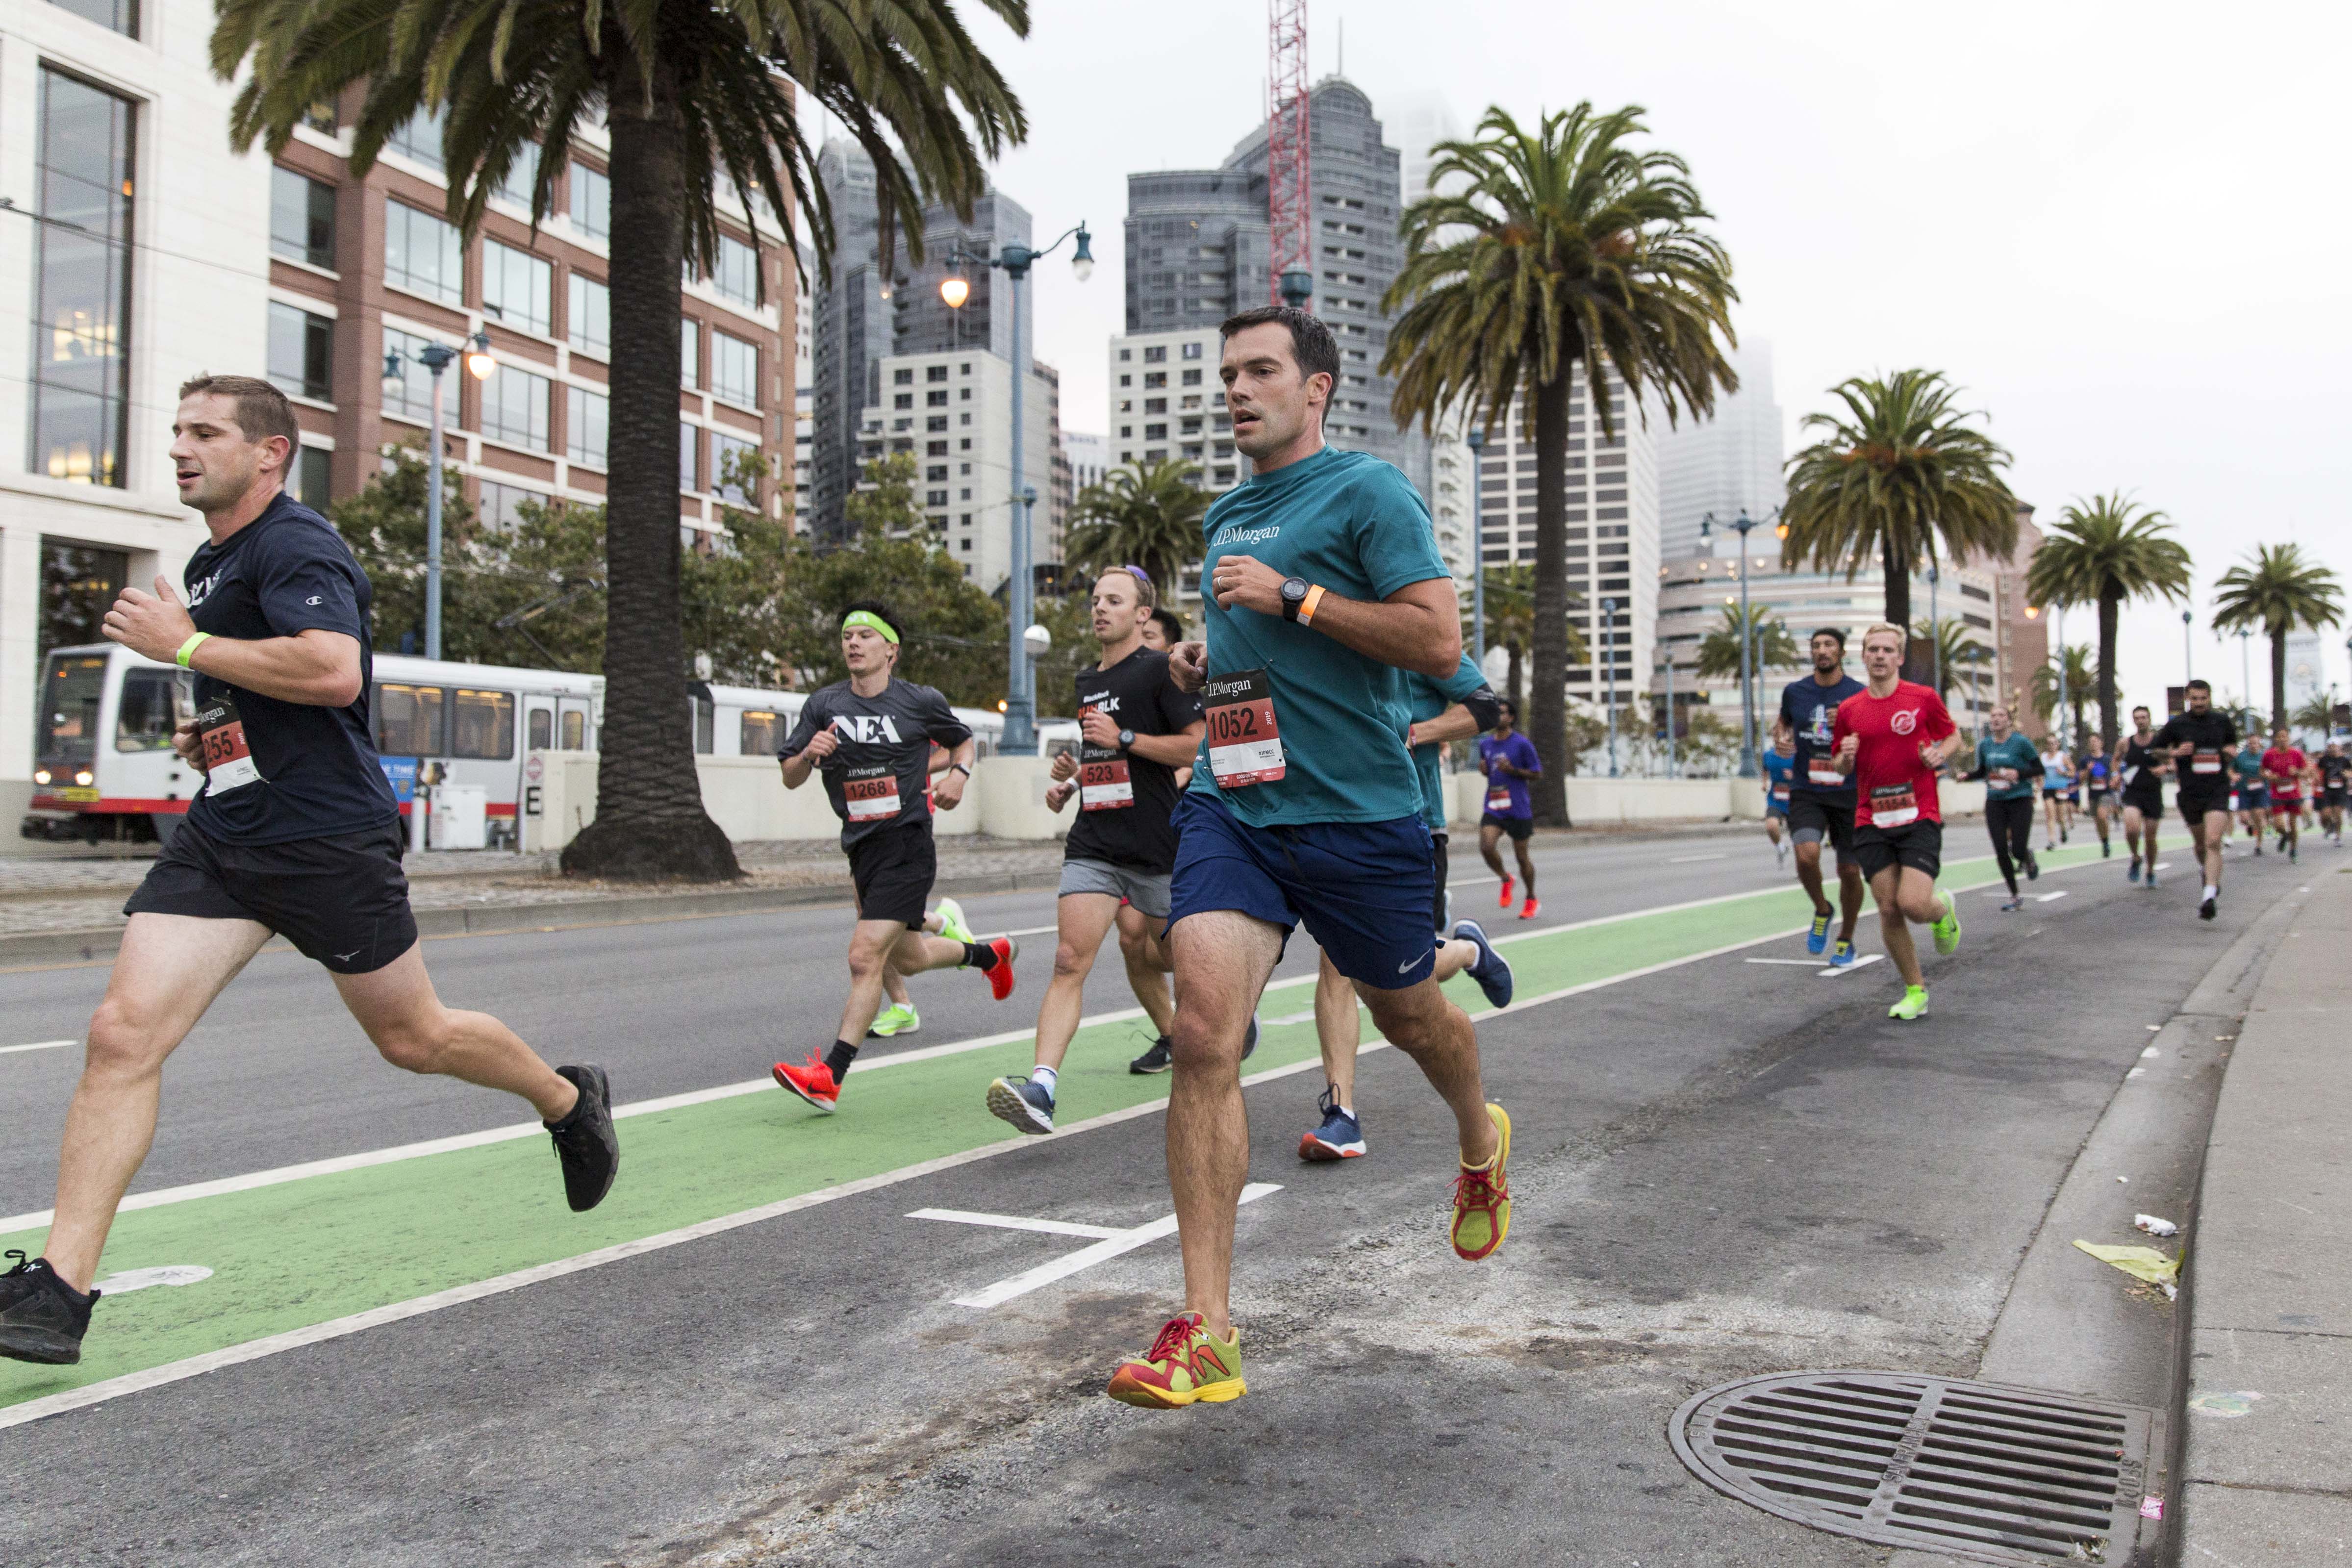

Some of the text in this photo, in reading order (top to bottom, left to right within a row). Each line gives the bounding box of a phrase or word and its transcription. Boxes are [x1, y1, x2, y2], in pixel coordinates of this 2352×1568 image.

[1214, 526, 1280, 547] J.P.Morgan
[1208, 679, 1252, 697] J.P.Morgan
[832, 714, 903, 744] NEA
[1210, 708, 1258, 741] 1052
[1084, 749, 1117, 759] J.P.Morgan
[847, 766, 886, 778] J.P.Morgan
[1087, 765, 1114, 783] 523
[850, 781, 887, 799] 1268
[526, 786, 542, 815] E
